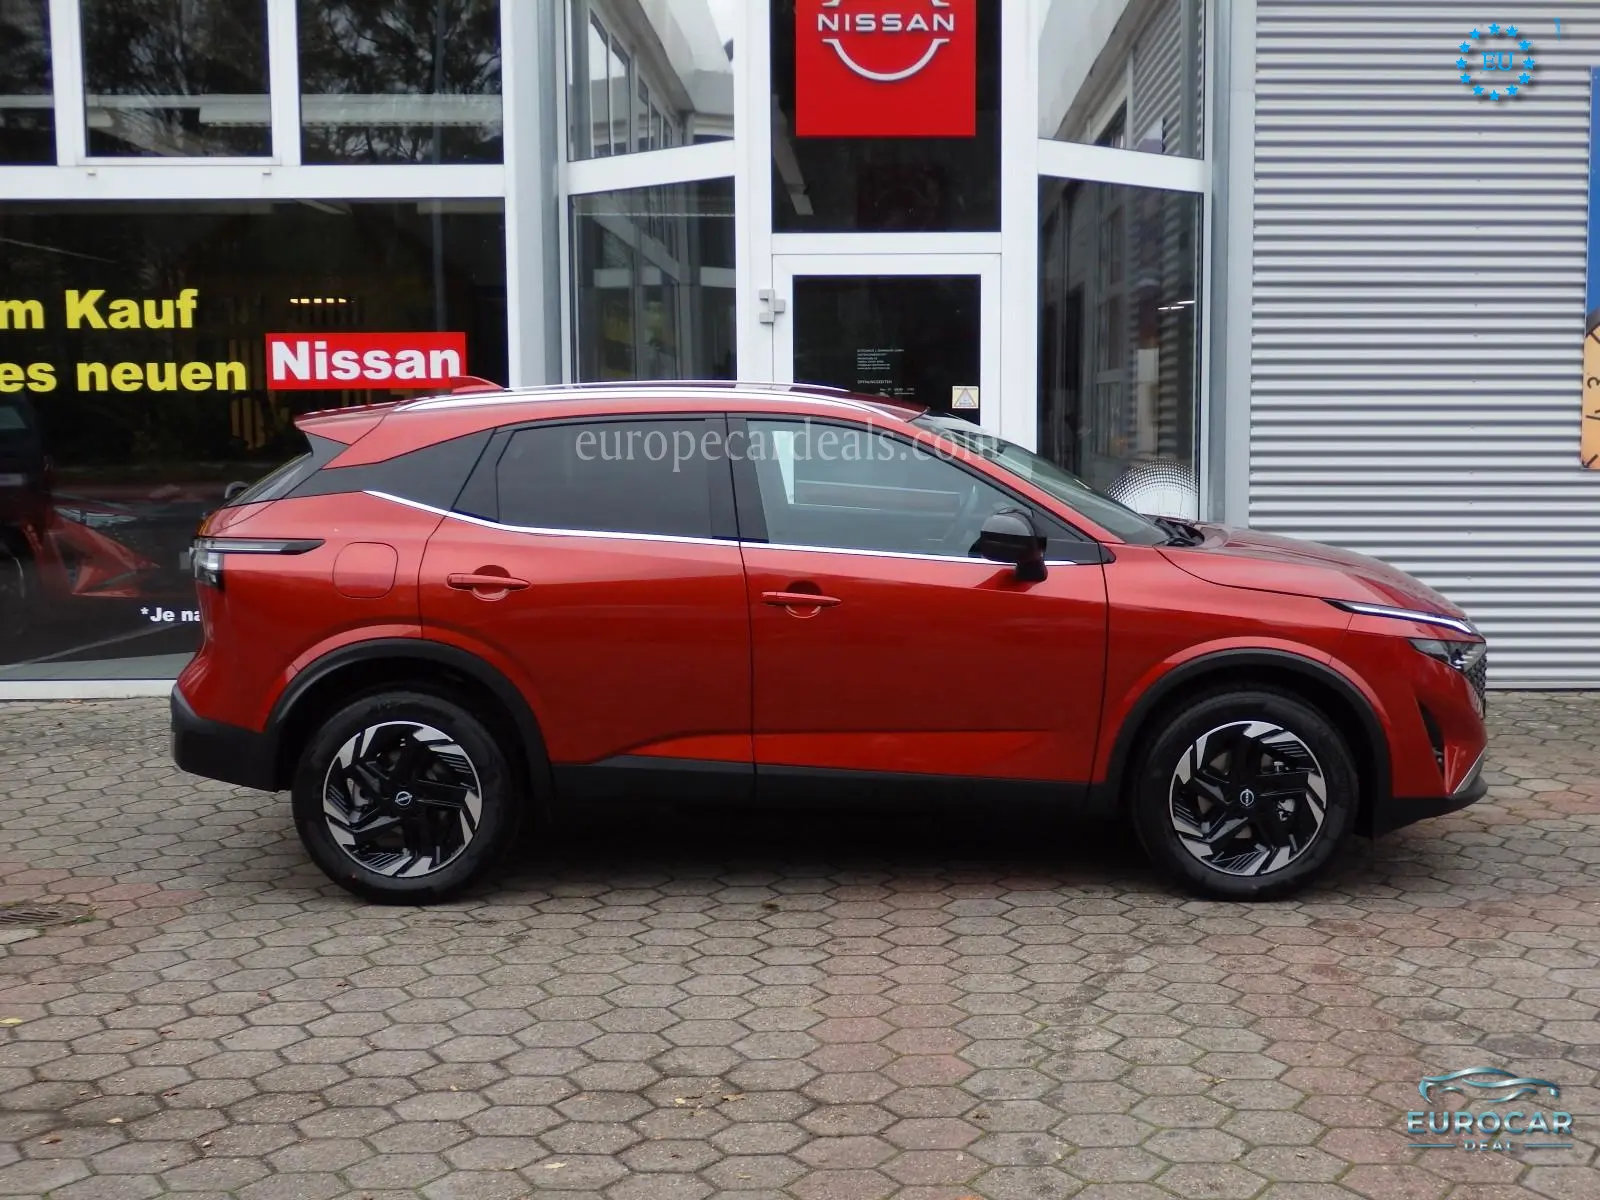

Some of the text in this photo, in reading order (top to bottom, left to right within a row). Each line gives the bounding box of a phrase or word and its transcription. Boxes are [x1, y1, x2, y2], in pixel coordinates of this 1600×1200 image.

[817, 13, 955, 32] NISSAN
[65, 288, 199, 330] Kauf
[76, 361, 248, 392] neuen
[271, 341, 461, 381] Nissan
